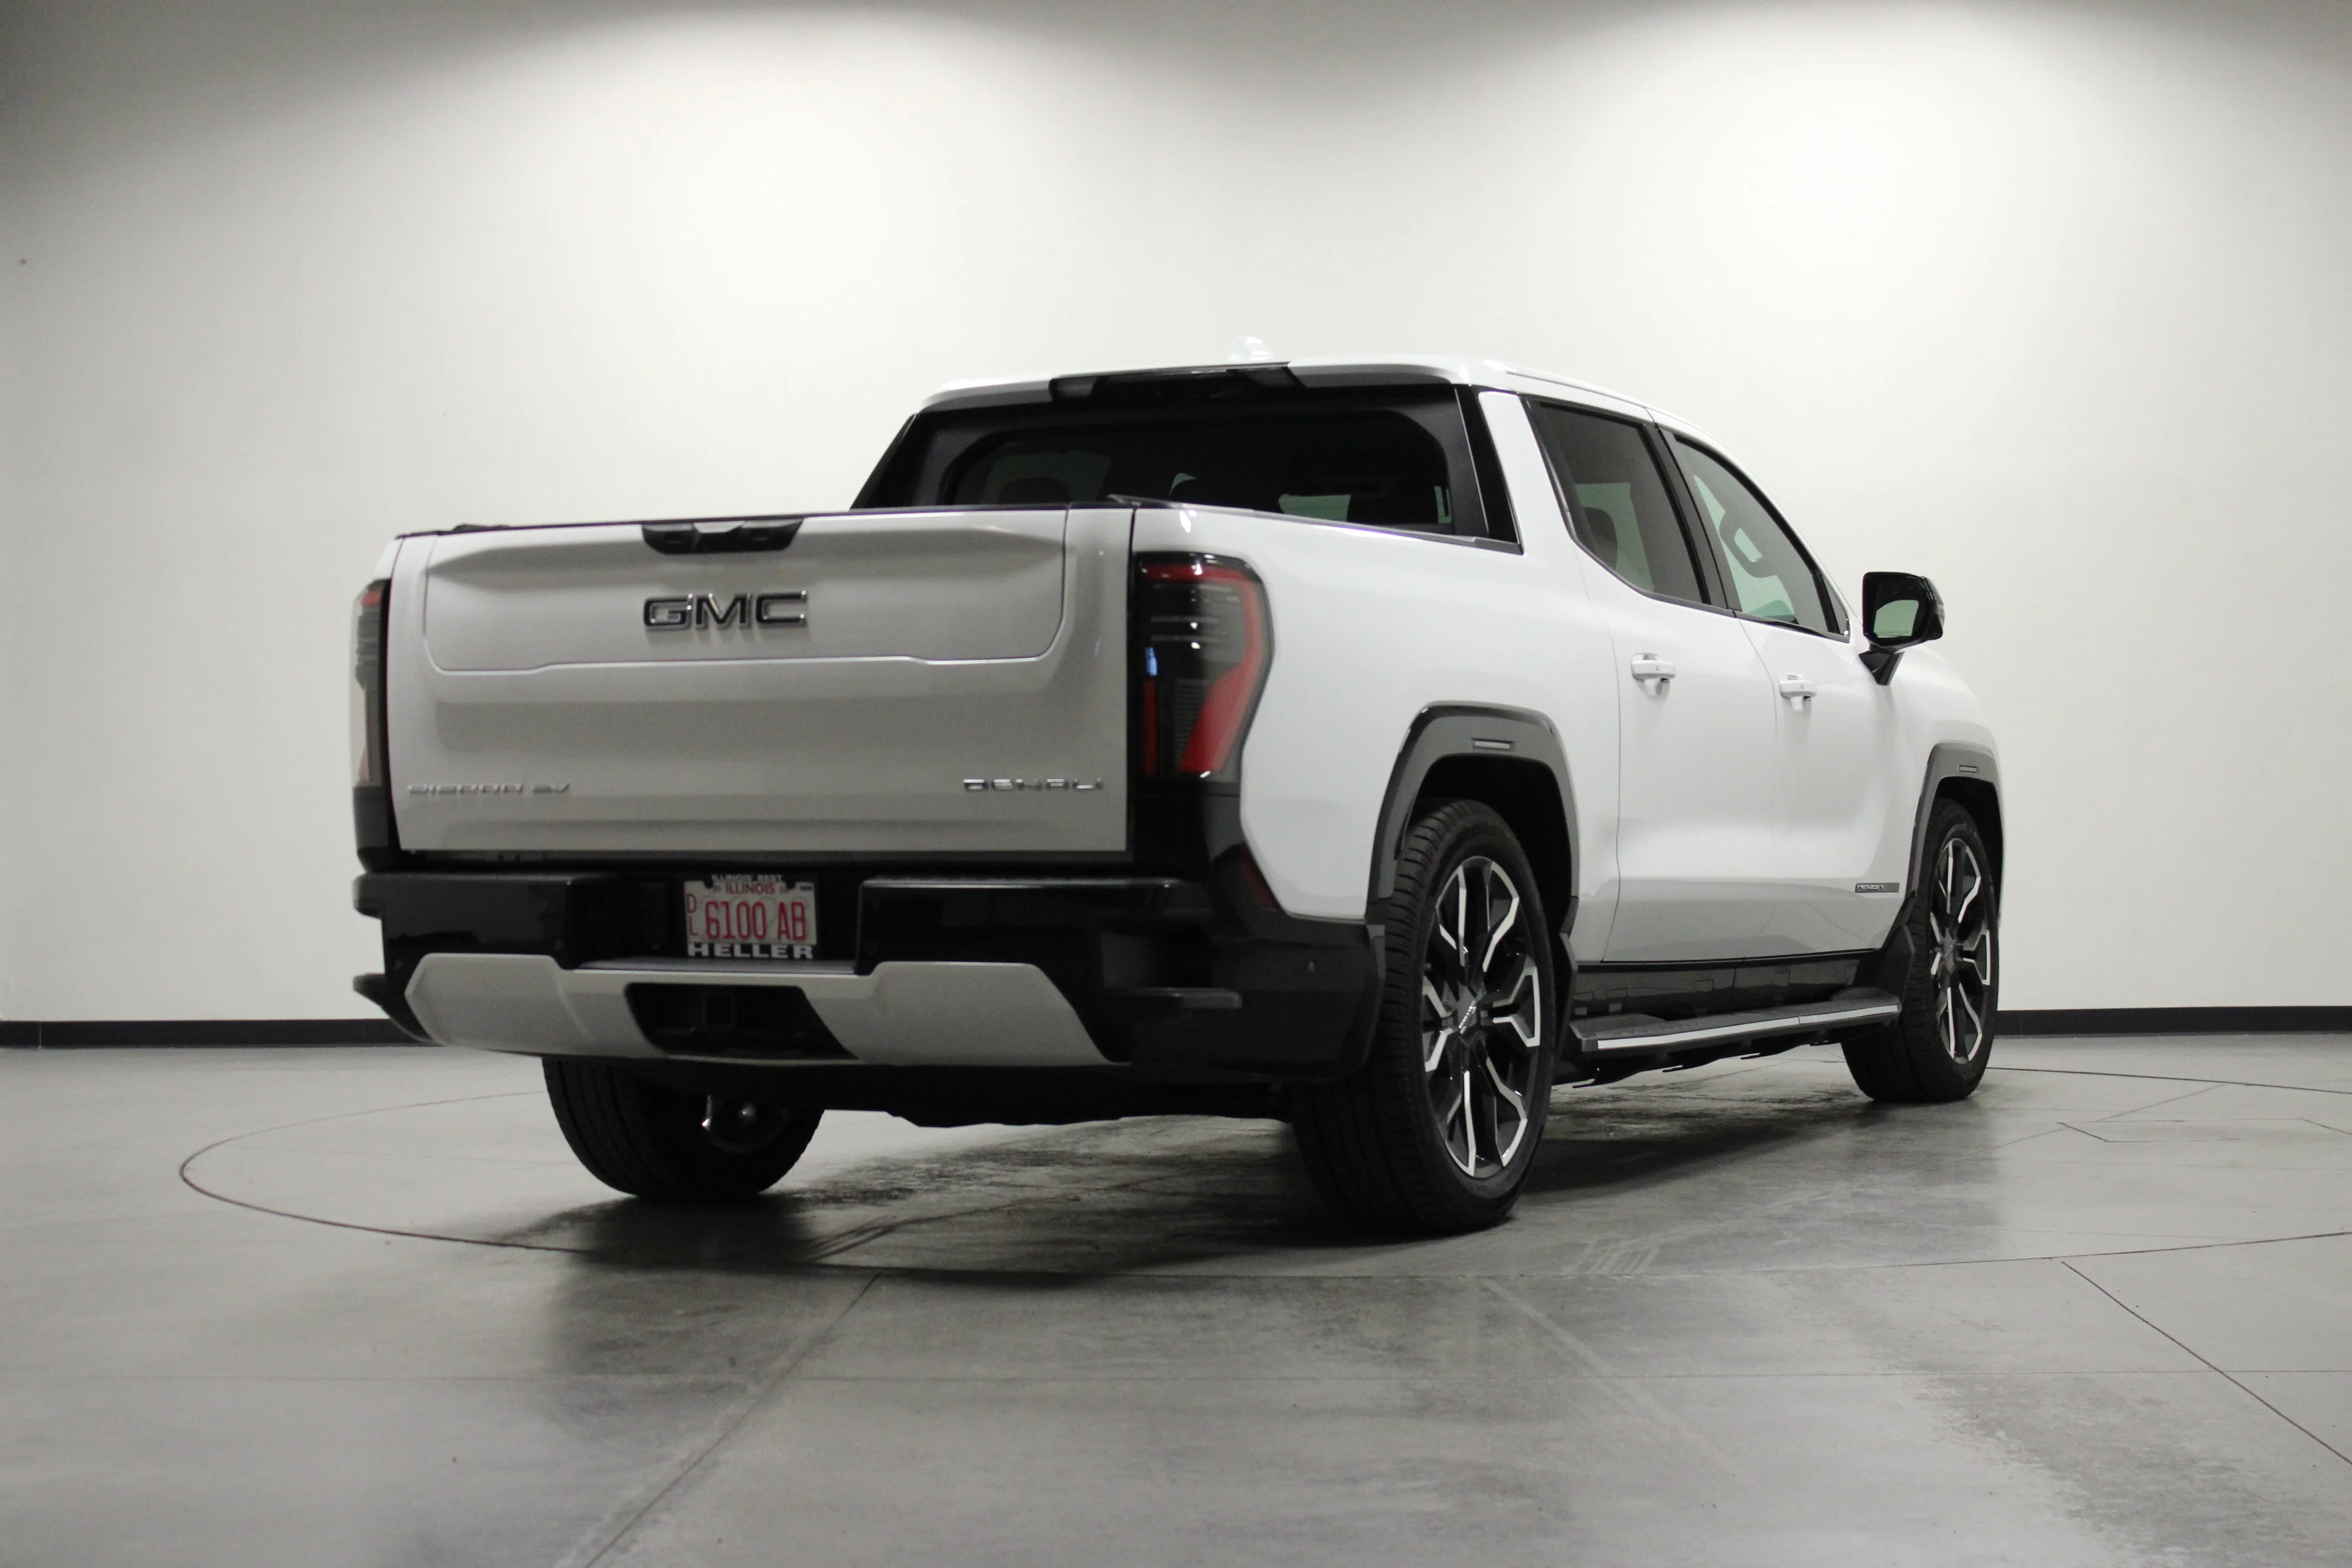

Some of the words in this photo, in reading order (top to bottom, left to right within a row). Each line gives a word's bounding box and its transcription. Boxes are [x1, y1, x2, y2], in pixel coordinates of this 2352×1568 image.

[644, 592, 807, 631] GMC
[725, 882, 776, 894] ILLINOIS
[705, 900, 766, 940] 6100
[777, 901, 807, 941] AB
[687, 943, 814, 959] HELLER
